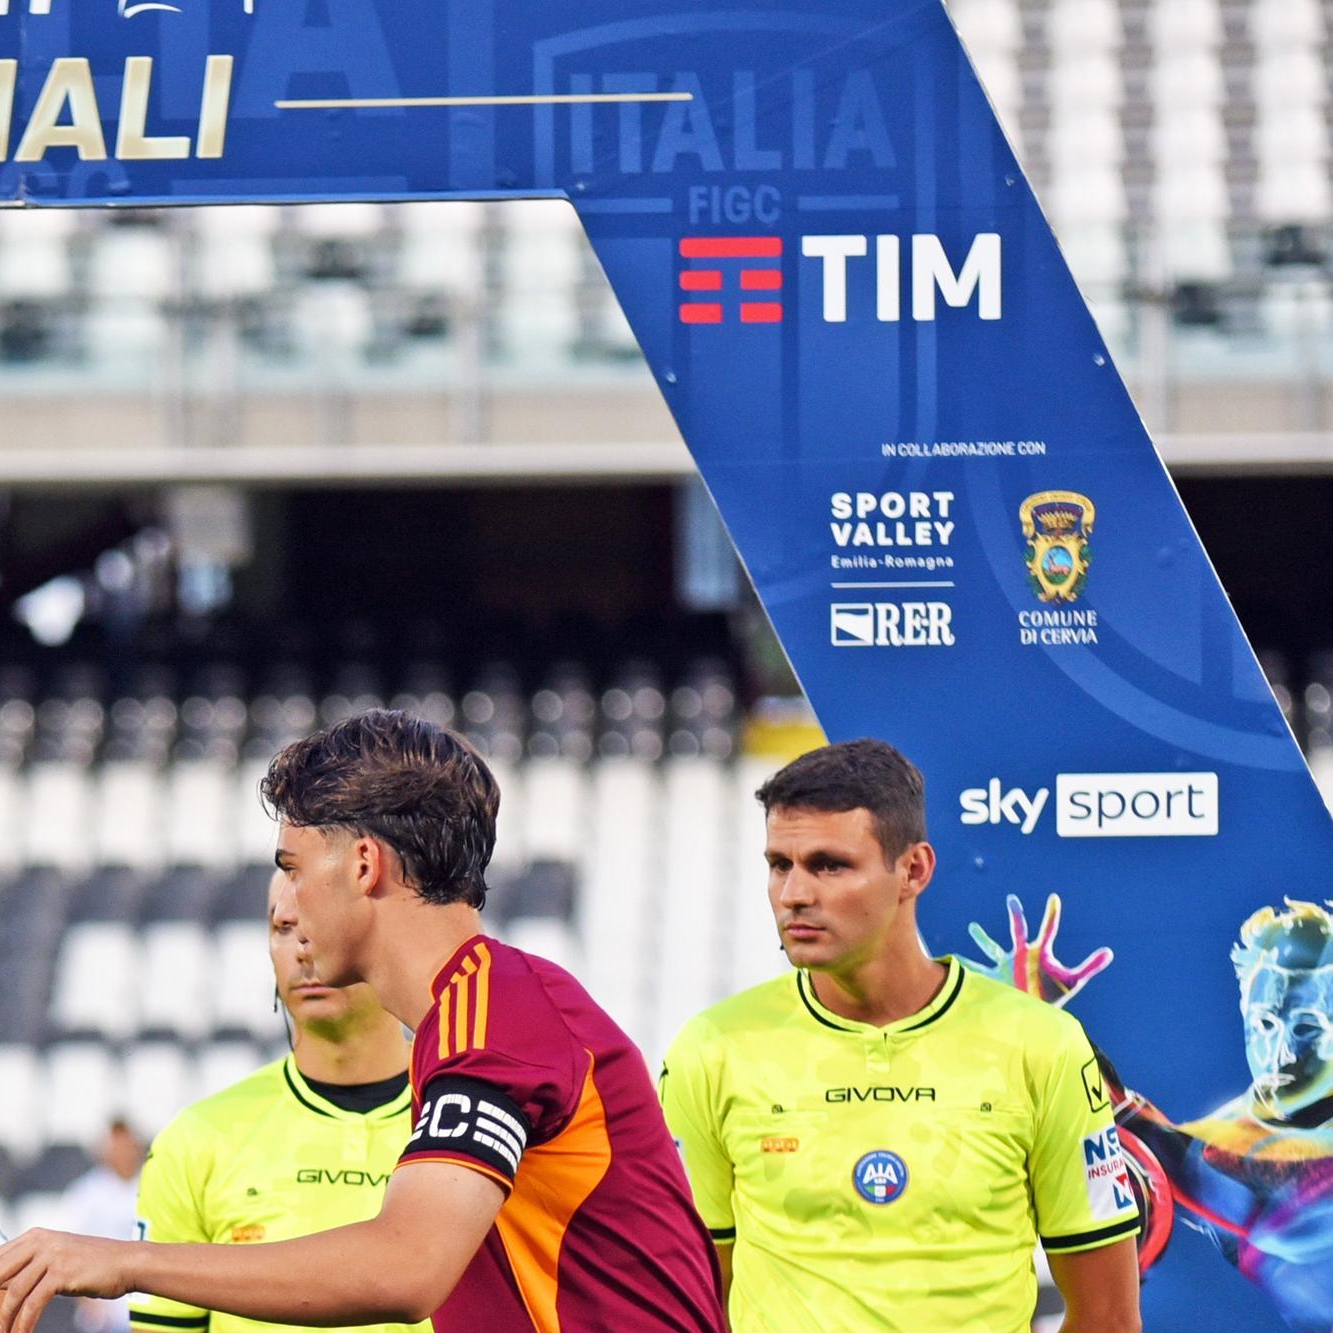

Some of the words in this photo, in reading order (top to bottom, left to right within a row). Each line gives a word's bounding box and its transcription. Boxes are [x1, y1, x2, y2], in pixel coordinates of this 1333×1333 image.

[571, 70, 897, 173] ITALIA
[689, 185, 782, 224] FIGC
[801, 233, 1002, 322] TIM
[881, 442, 896, 457] IN
[898, 442, 1016, 457] COLLABORAZIONE
[1017, 441, 1046, 455] CON
[831, 491, 954, 519] SPORT
[830, 521, 955, 546] VALLEY
[831, 554, 954, 571] Emilia-Romagna
[1018, 610, 1098, 627] COMUNE
[1021, 629, 1038, 645] DI
[1041, 628, 1099, 645] CERVIA
[959, 777, 1049, 834] sky
[1069, 784, 1205, 828] sport
[825, 1087, 936, 1102] GIVOVA
[297, 1168, 391, 1187] GIVOV
[863, 1163, 898, 1185] AIA
